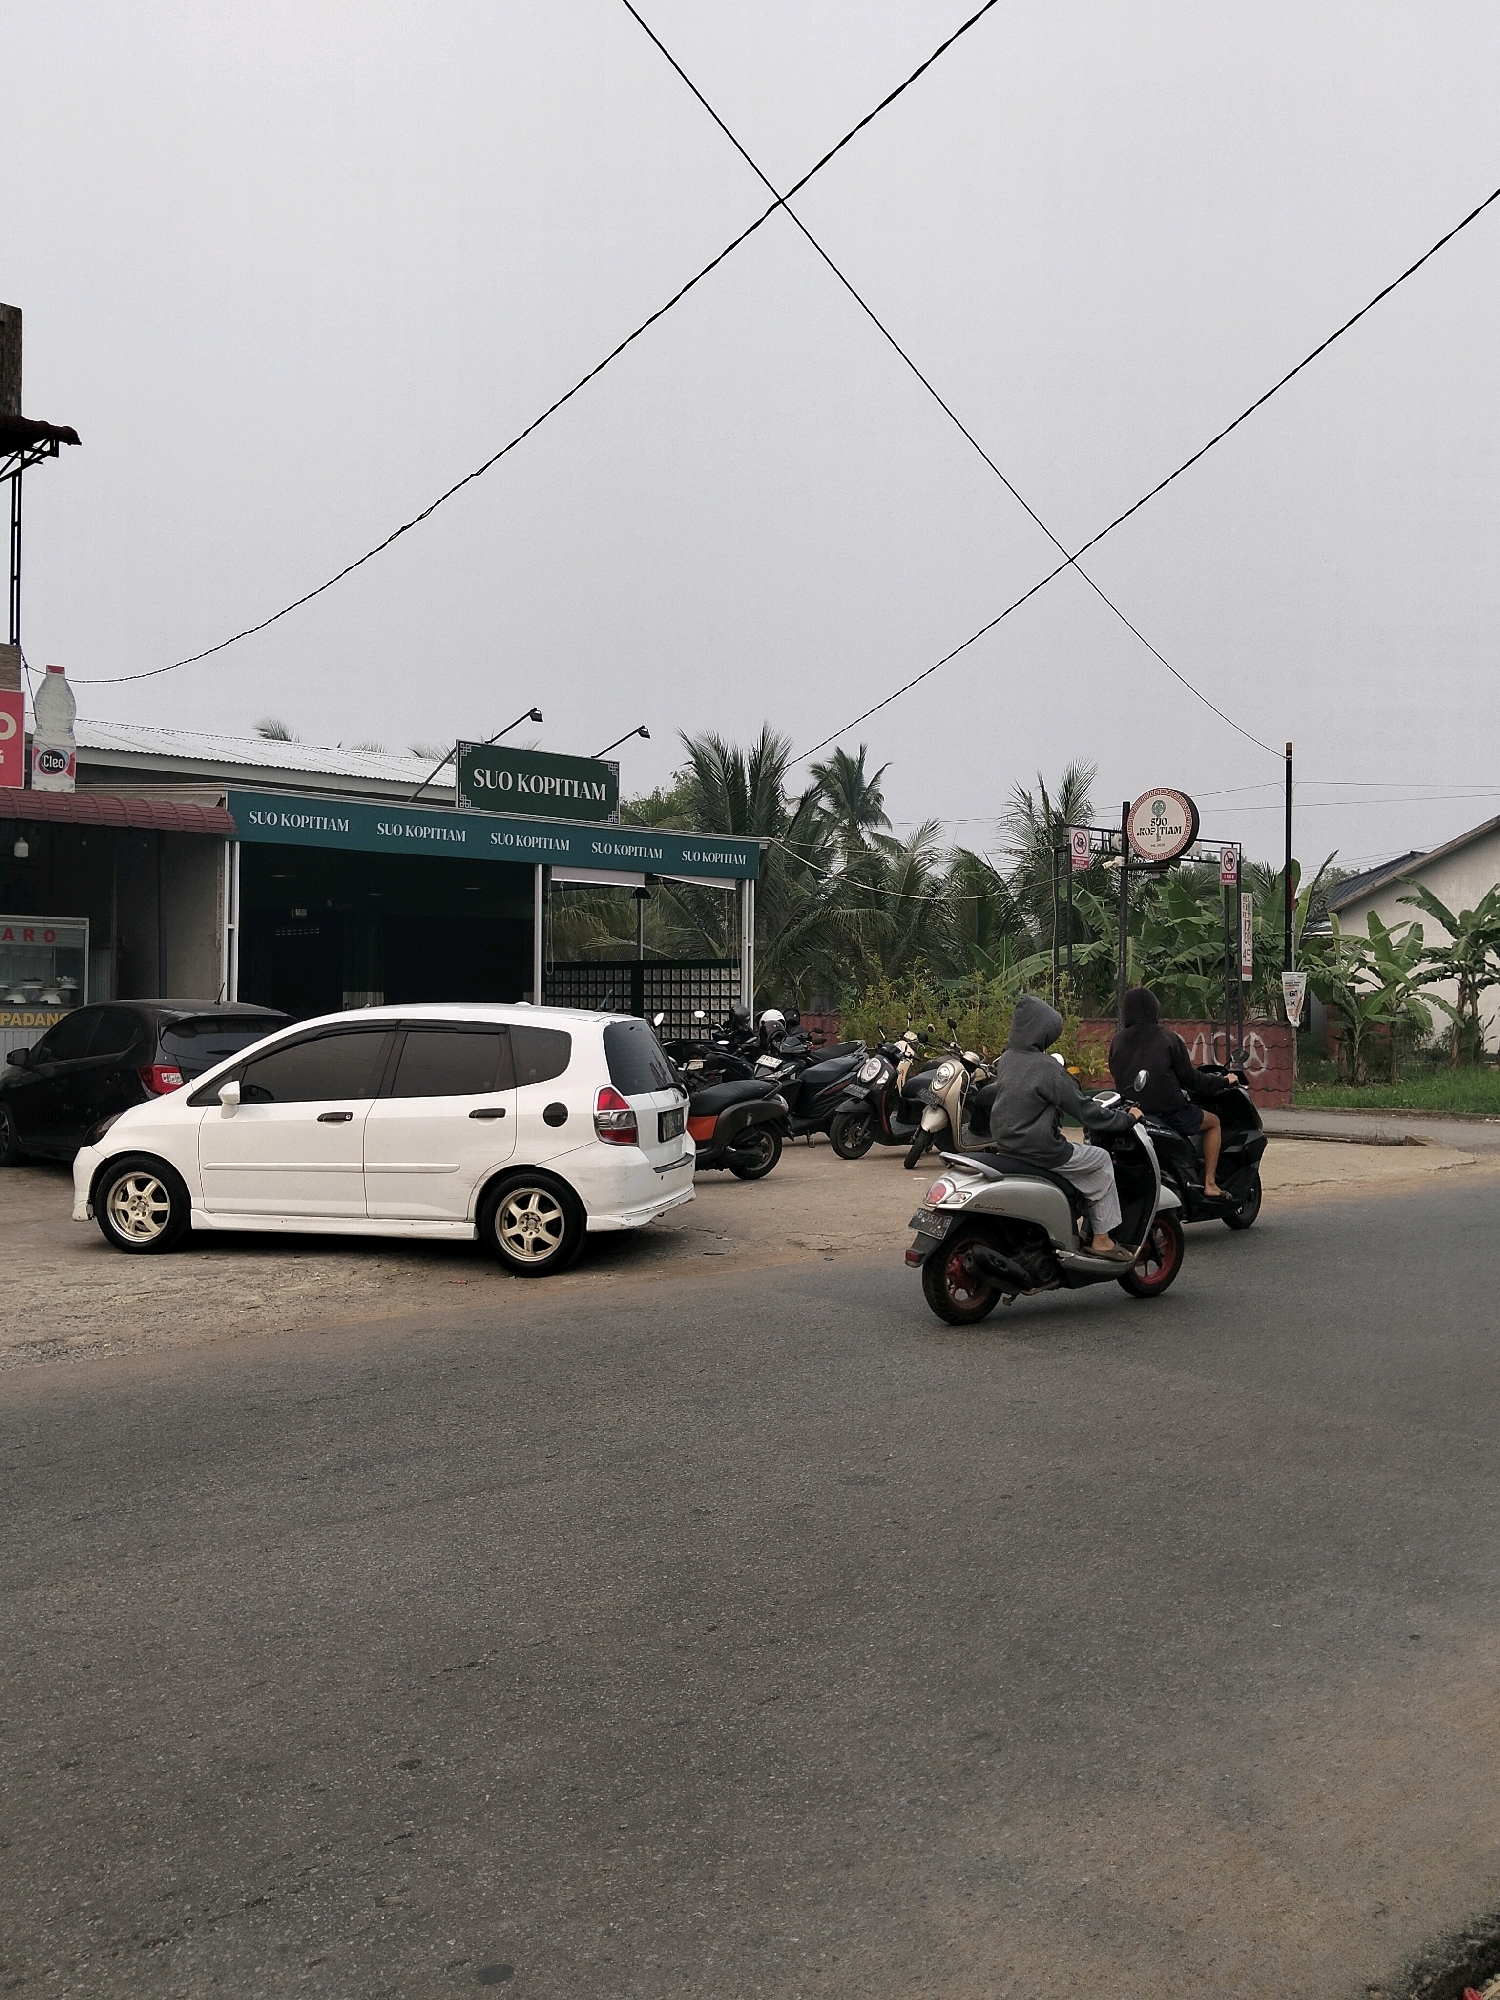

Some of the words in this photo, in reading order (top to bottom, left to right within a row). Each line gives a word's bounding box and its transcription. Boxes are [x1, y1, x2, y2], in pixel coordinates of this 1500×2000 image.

[43, 754, 64, 769] Cleo
[473, 768, 513, 791] SUO
[517, 773, 607, 802] KOPITIAM
[249, 810, 278, 826] SUO
[281, 813, 350, 832] KOPITIAM
[1150, 817, 1168, 827] SUO
[376, 822, 403, 837] SUO
[405, 824, 466, 842] KOPITIAM
[490, 832, 514, 847] SUO
[516, 834, 570, 851] KOPITIAM
[591, 841, 612, 855] SUO
[614, 844, 663, 860] KOPITIAM
[681, 850, 701, 862] SUO
[702, 852, 747, 866] KOPITIAM
[2, 927, 57, 943] ARO
